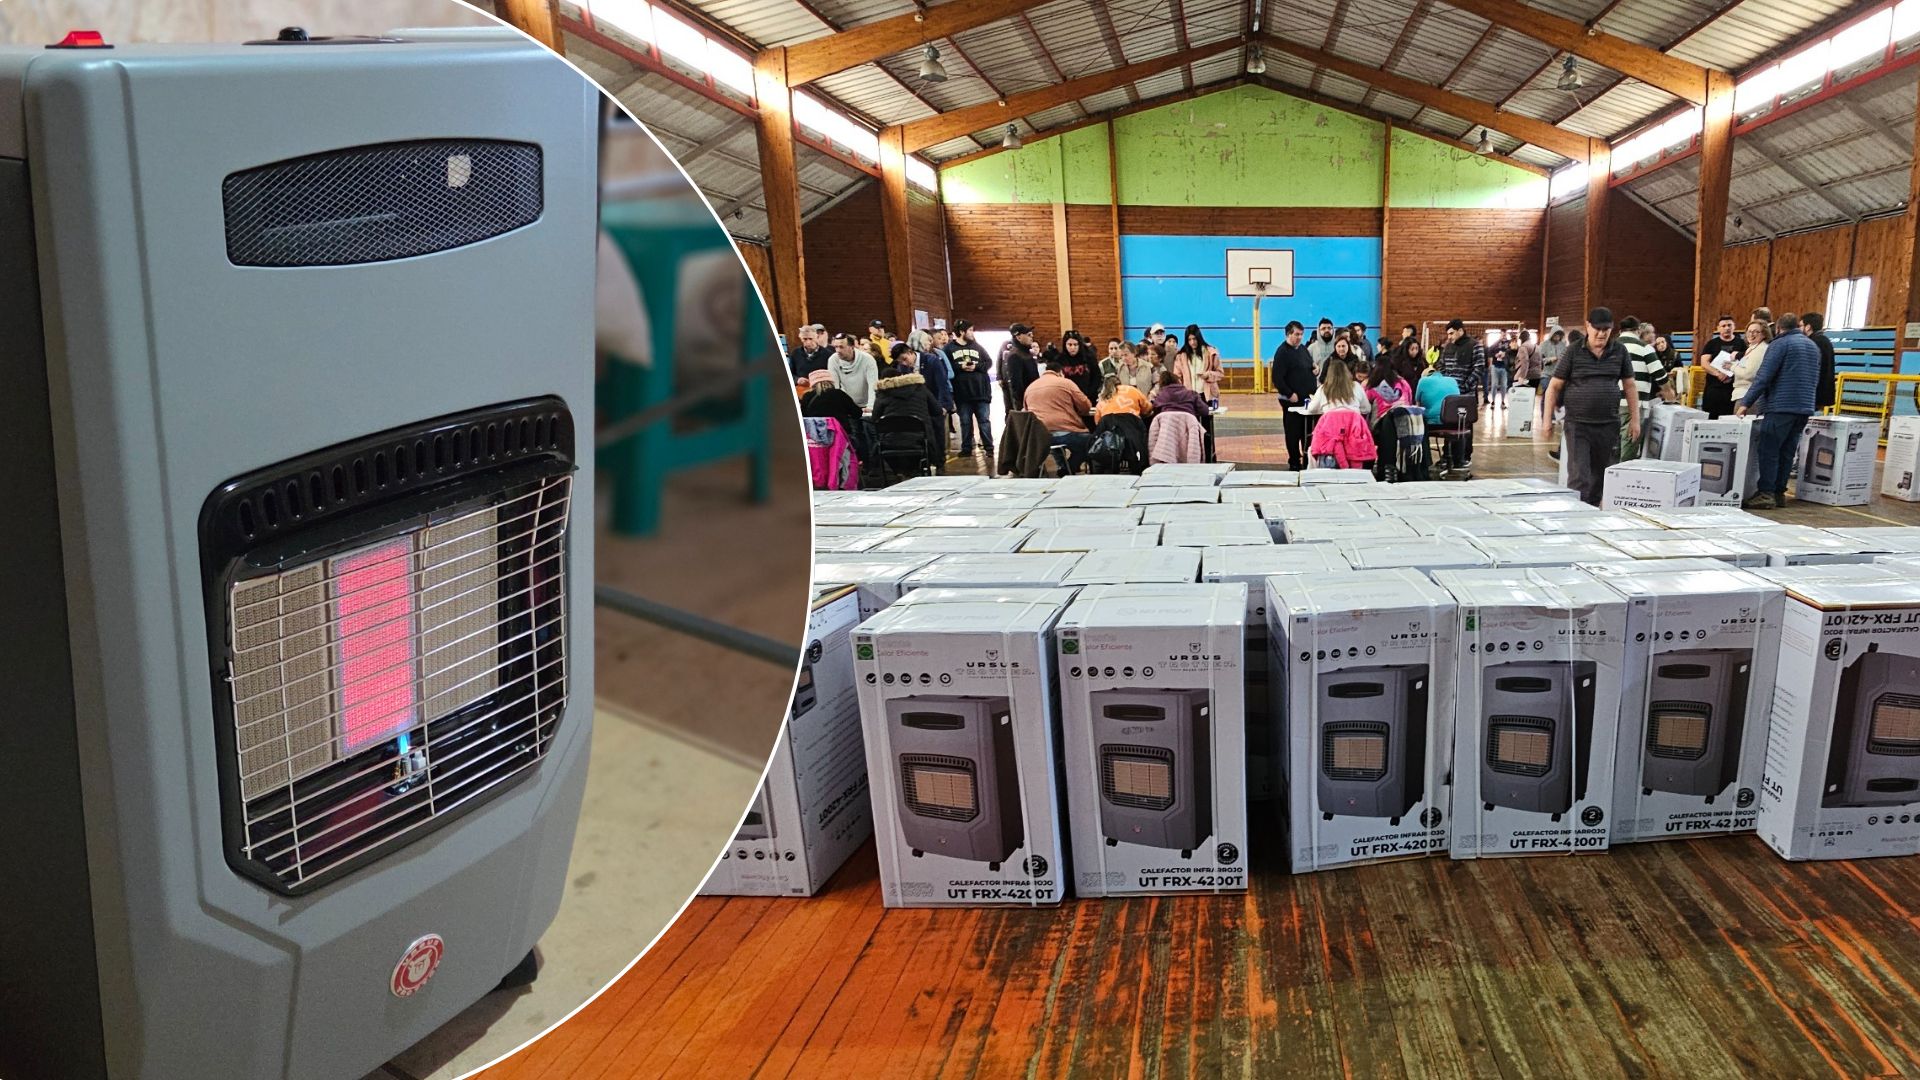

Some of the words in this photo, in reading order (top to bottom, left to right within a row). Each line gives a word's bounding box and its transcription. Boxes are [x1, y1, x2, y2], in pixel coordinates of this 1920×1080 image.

[1669, 811, 1712, 820] CALEFACTOR
[1666, 821, 1683, 832] UT
[1353, 833, 1399, 844] CALEFACTOR
[1400, 829, 1445, 838] INFRAROJO
[1351, 846, 1368, 856] UT
[1372, 837, 1445, 855] FRX-4200T
[1510, 839, 1528, 849] UT
[1532, 837, 1606, 849] FRX-4200T
[1138, 876, 1159, 887] UT
[1163, 875, 1243, 887] FRX-4200T
[948, 889, 970, 899] UT
